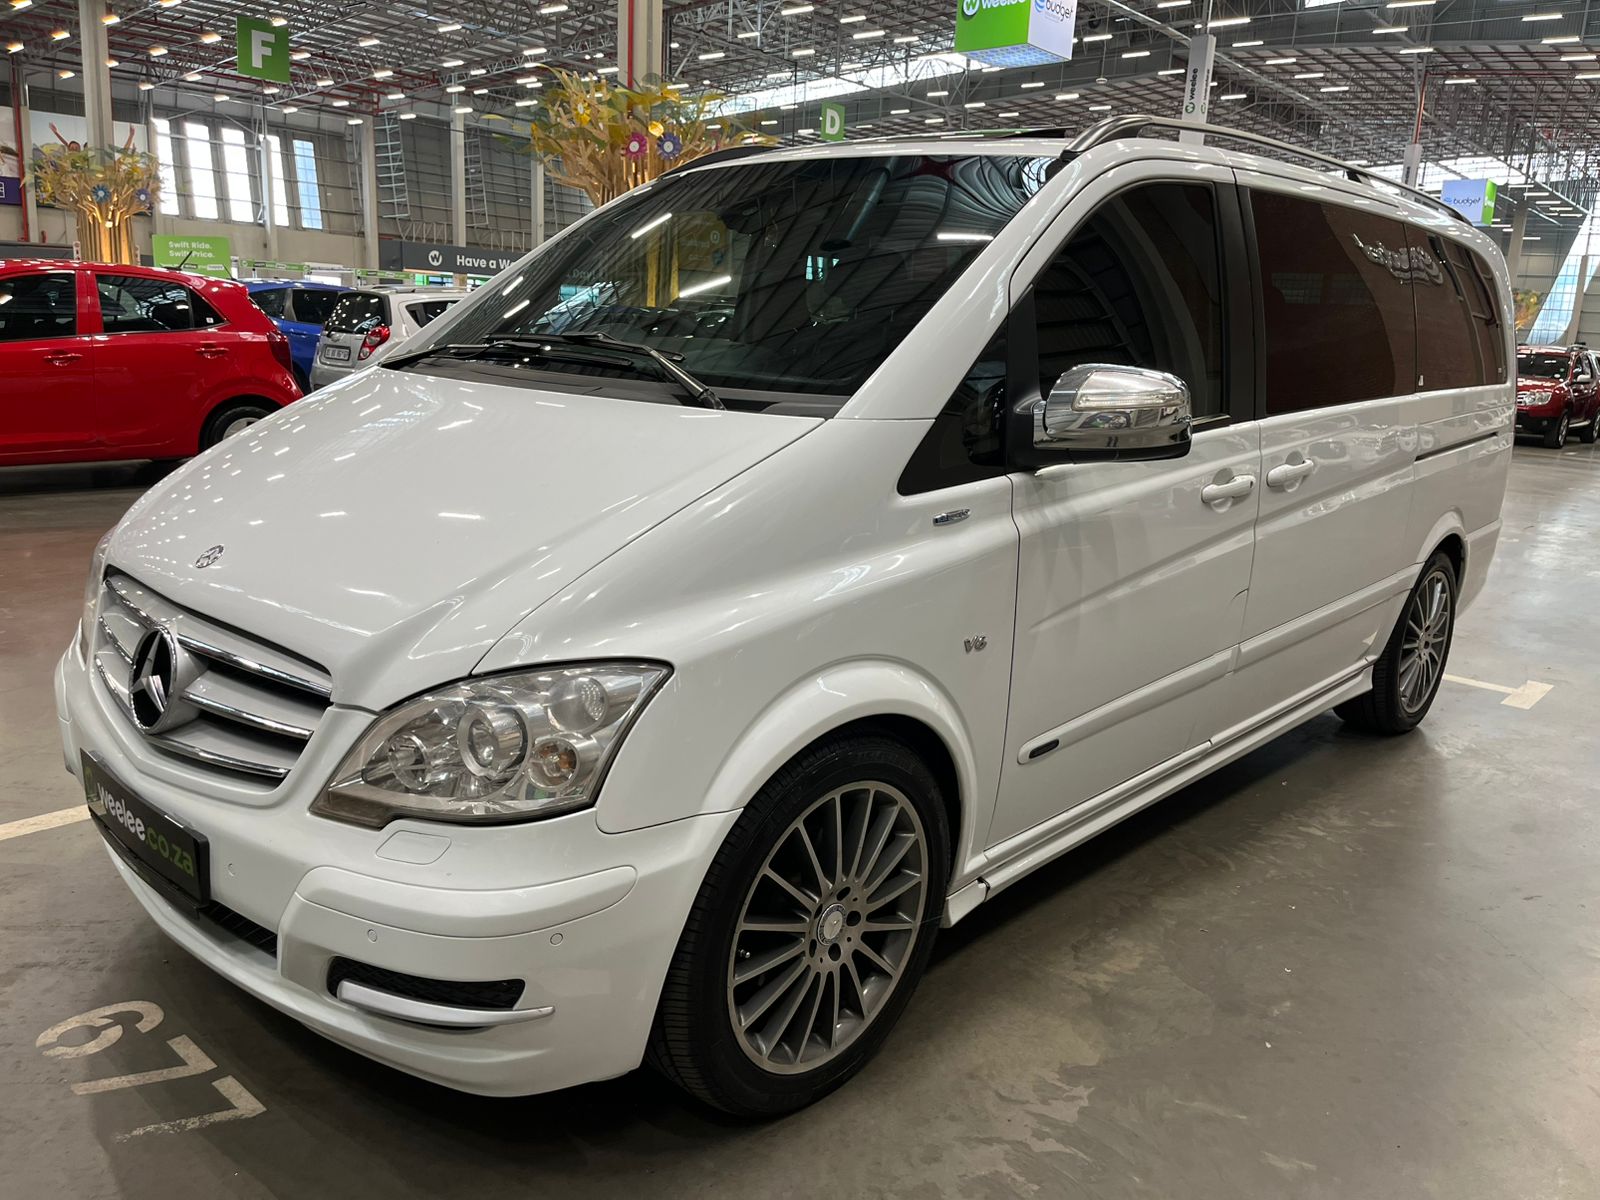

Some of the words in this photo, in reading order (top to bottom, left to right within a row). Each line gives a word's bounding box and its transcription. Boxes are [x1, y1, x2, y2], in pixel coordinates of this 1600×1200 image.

[251, 30, 275, 69] F
[825, 108, 840, 135] D
[168, 241, 189, 249] Swift
[456, 254, 487, 268] Have
[489, 260, 497, 269] a
[963, 635, 987, 654] V6
[97, 782, 195, 877] weelee.co.za
